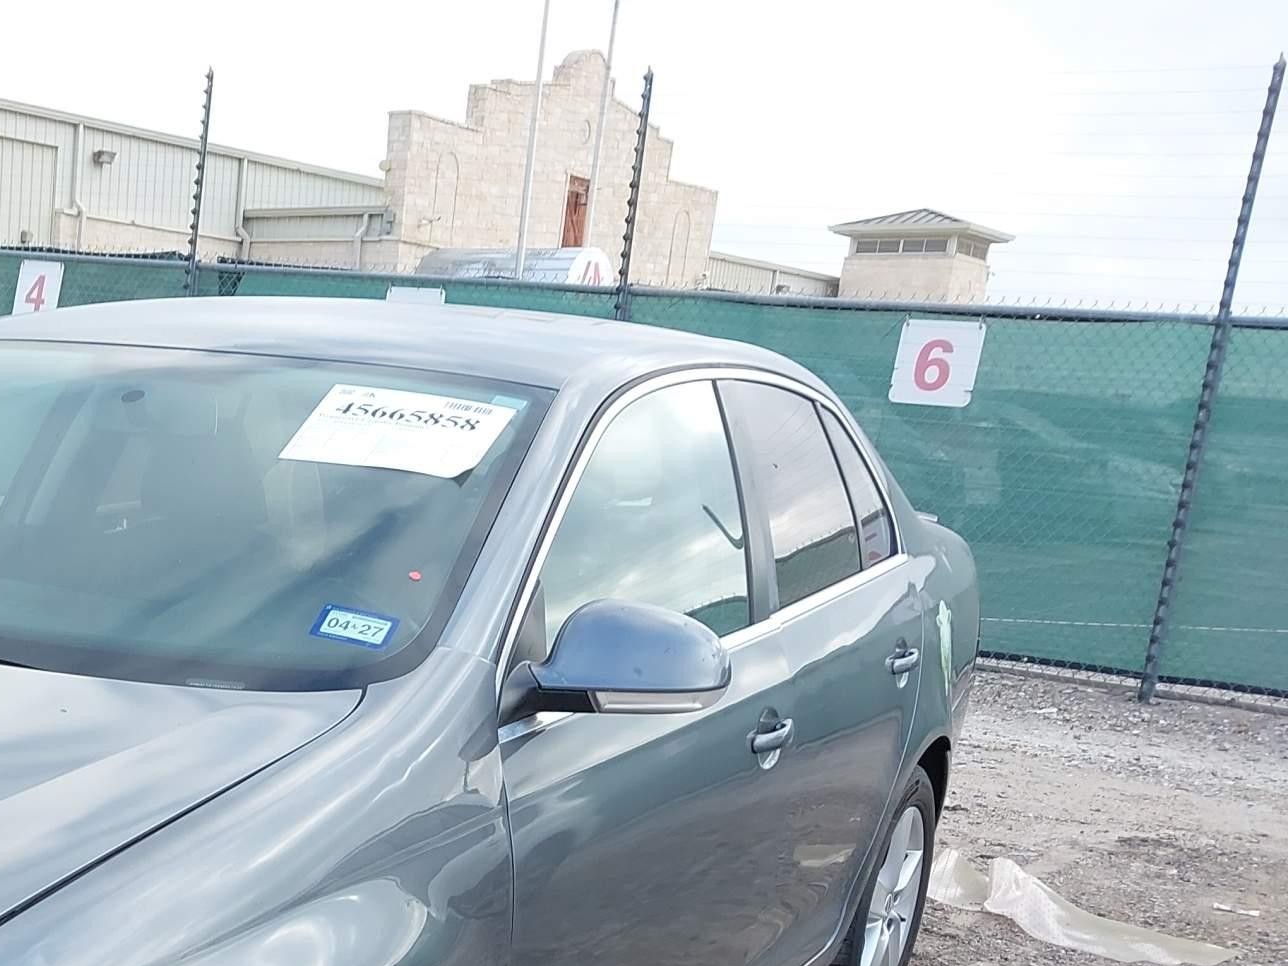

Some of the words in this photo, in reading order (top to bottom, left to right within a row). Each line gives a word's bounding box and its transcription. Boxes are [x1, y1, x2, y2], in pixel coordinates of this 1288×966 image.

[24, 274, 46, 312] 4
[914, 339, 954, 391] 6
[336, 401, 481, 432] 45665858
[327, 617, 351, 631] 04
[358, 623, 385, 638] 27
